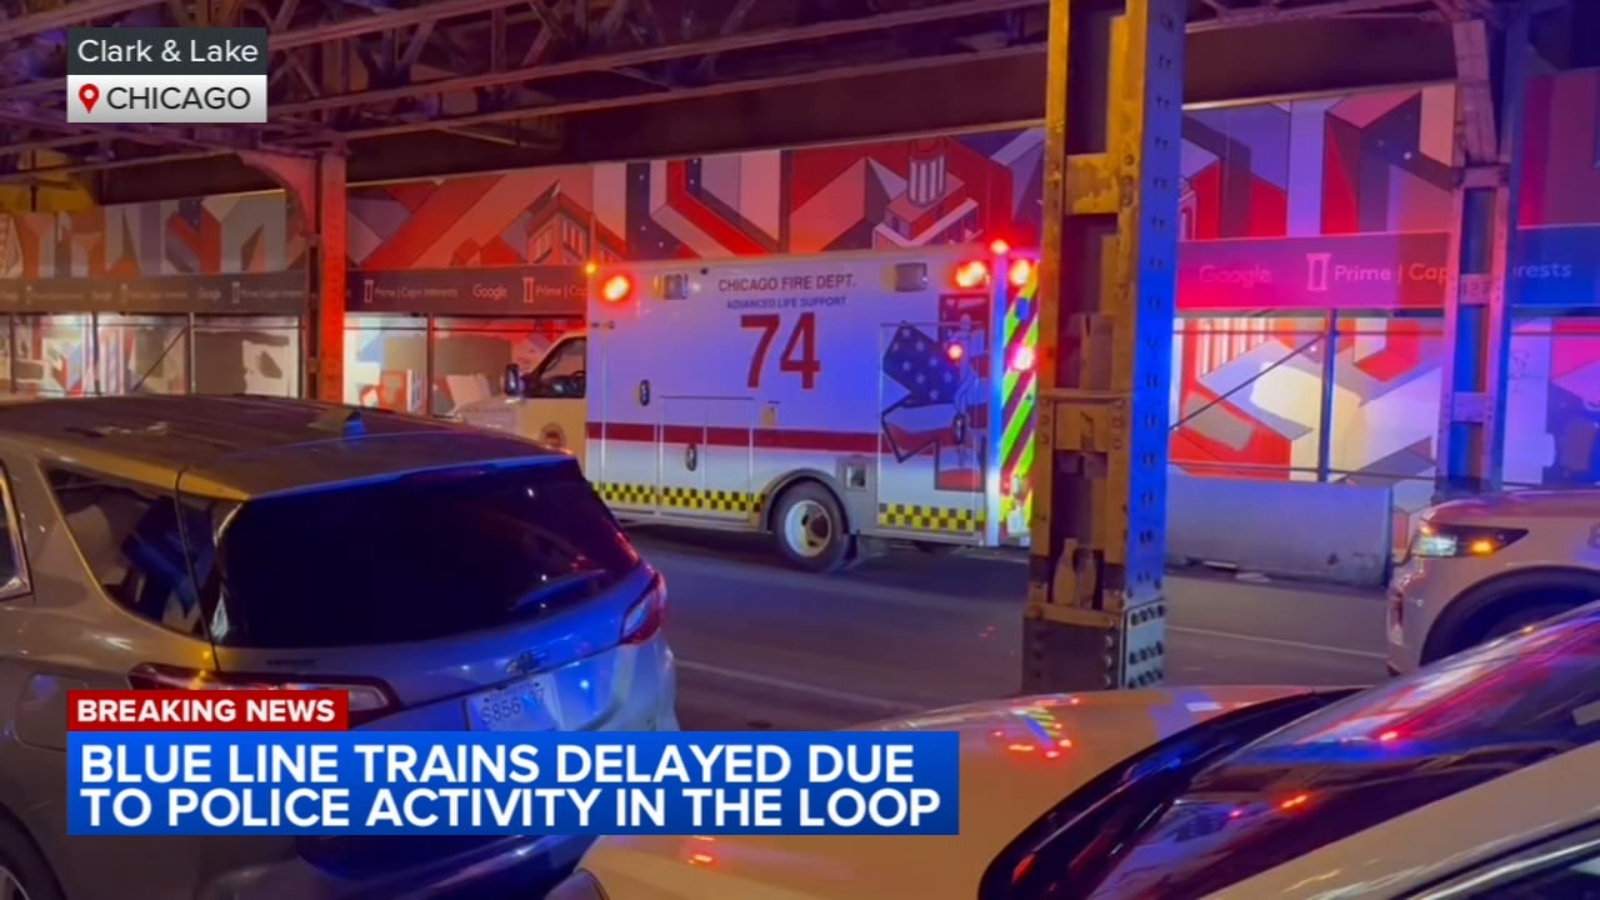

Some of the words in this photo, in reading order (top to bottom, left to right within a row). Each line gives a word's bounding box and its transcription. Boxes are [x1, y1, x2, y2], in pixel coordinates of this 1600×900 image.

[1200, 264, 1273, 289] Google
[1334, 264, 1391, 282] Prime
[1512, 263, 1573, 279] rests
[472, 283, 508, 300] Google
[718, 277, 779, 292] CHICAGO
[781, 276, 813, 290] FIRE
[816, 273, 857, 290] DEPT.
[727, 298, 776, 310] ADVANCED
[777, 298, 798, 309] LIFE
[799, 295, 847, 308] SUPPORT
[740, 311, 821, 390] 74
